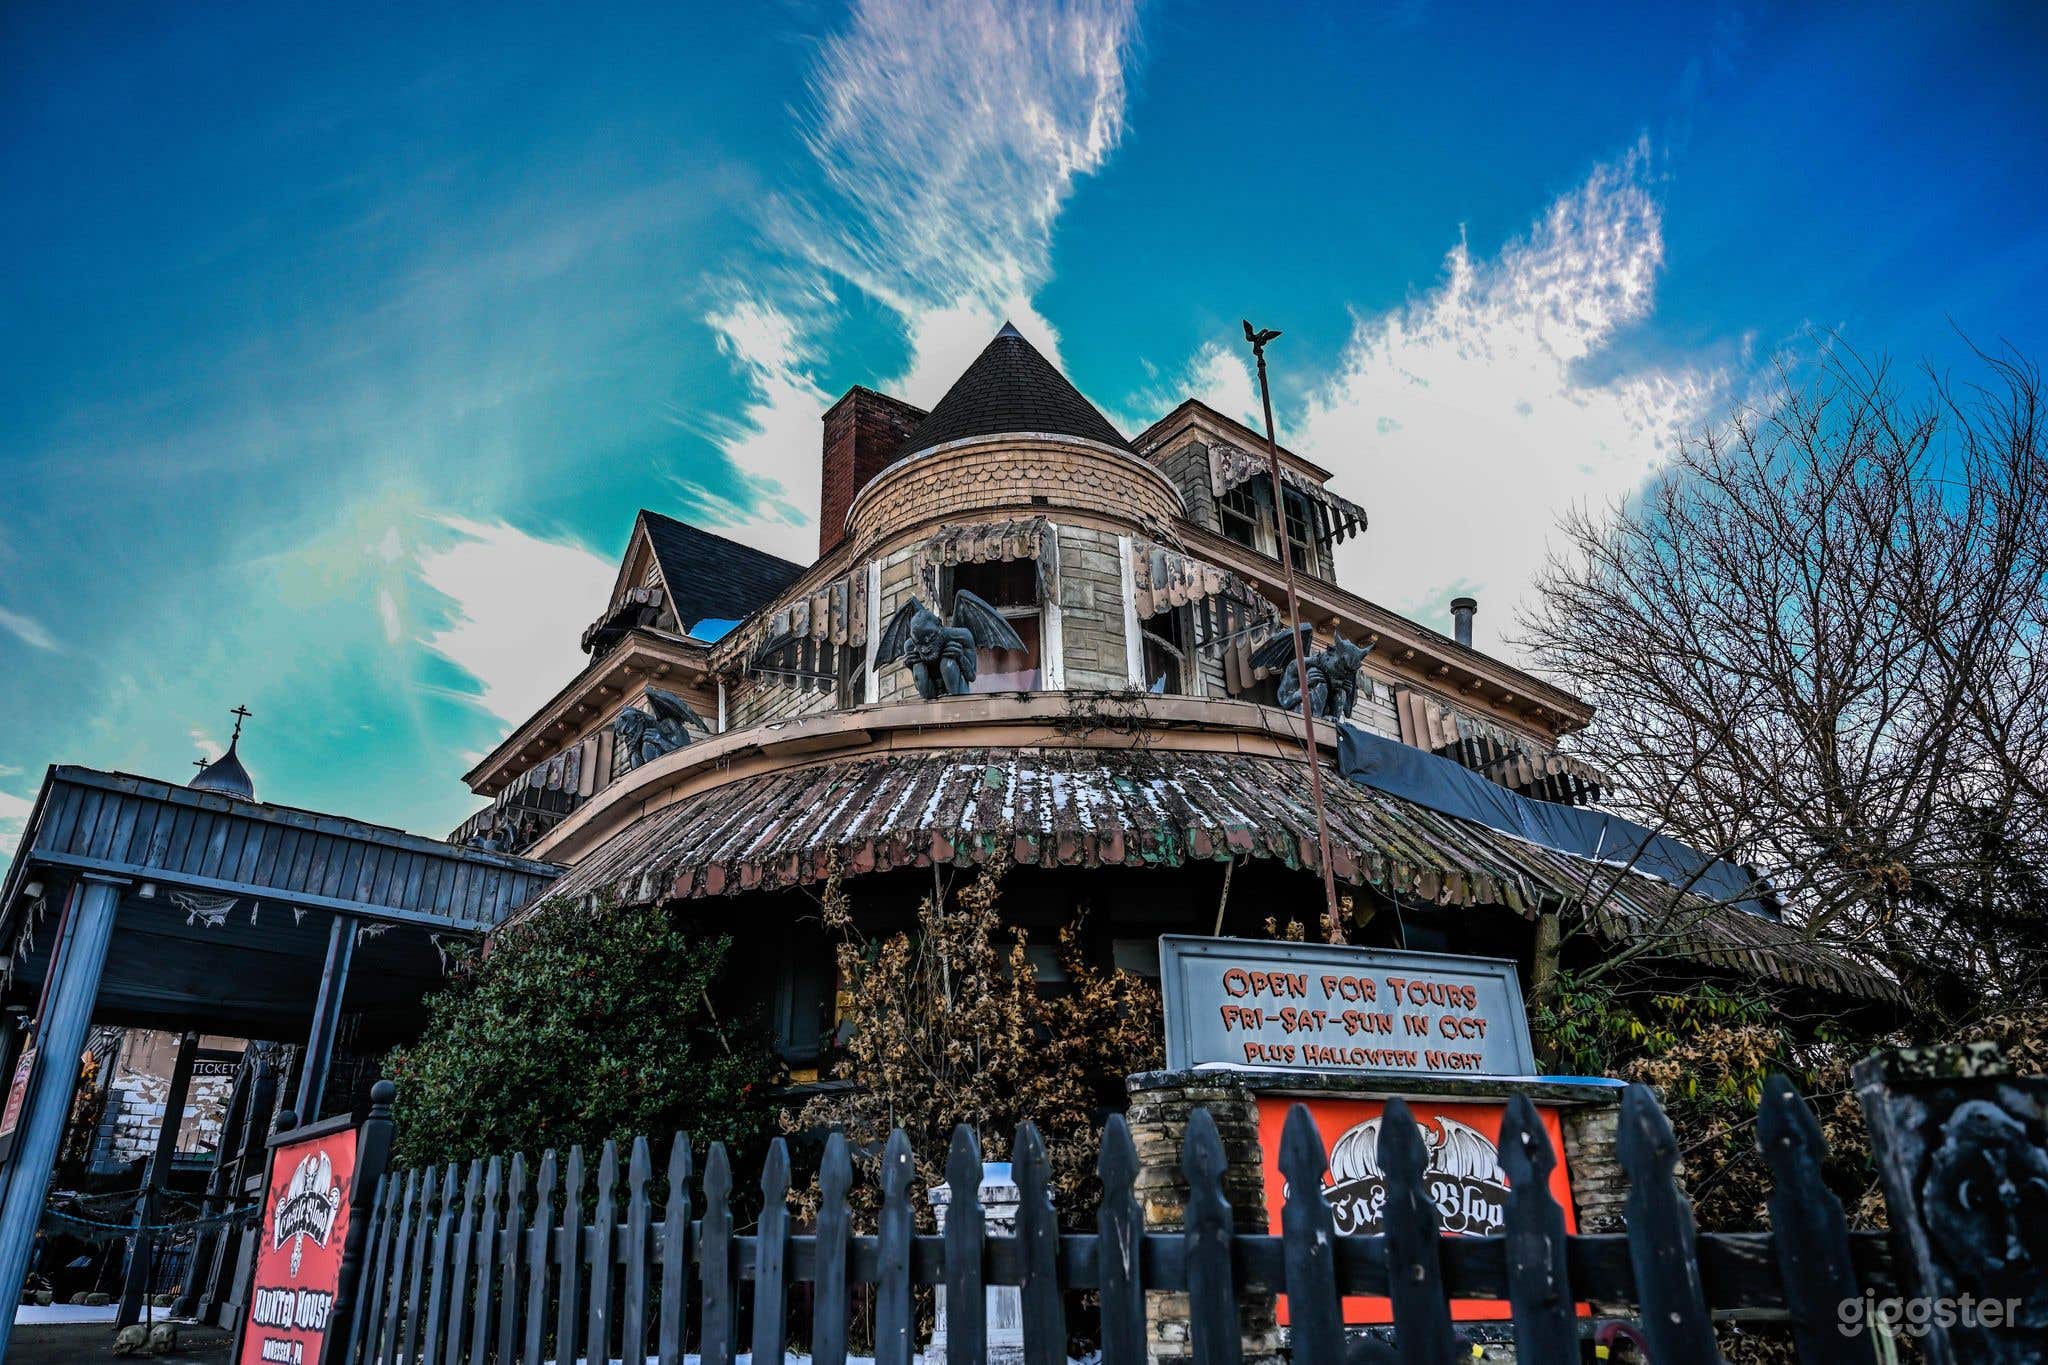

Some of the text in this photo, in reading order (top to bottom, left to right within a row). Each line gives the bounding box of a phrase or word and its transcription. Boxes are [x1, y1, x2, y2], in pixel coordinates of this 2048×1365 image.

[1222, 967, 1478, 1011] OPEN FOR TOURS
[1221, 1004, 1487, 1041] FRI-SAT-SUN IN OCT
[1244, 1042, 1483, 1071] PLUS HALLOWEEN NIGHT
[253, 1289, 333, 1329] HAUNTED HOUSE
